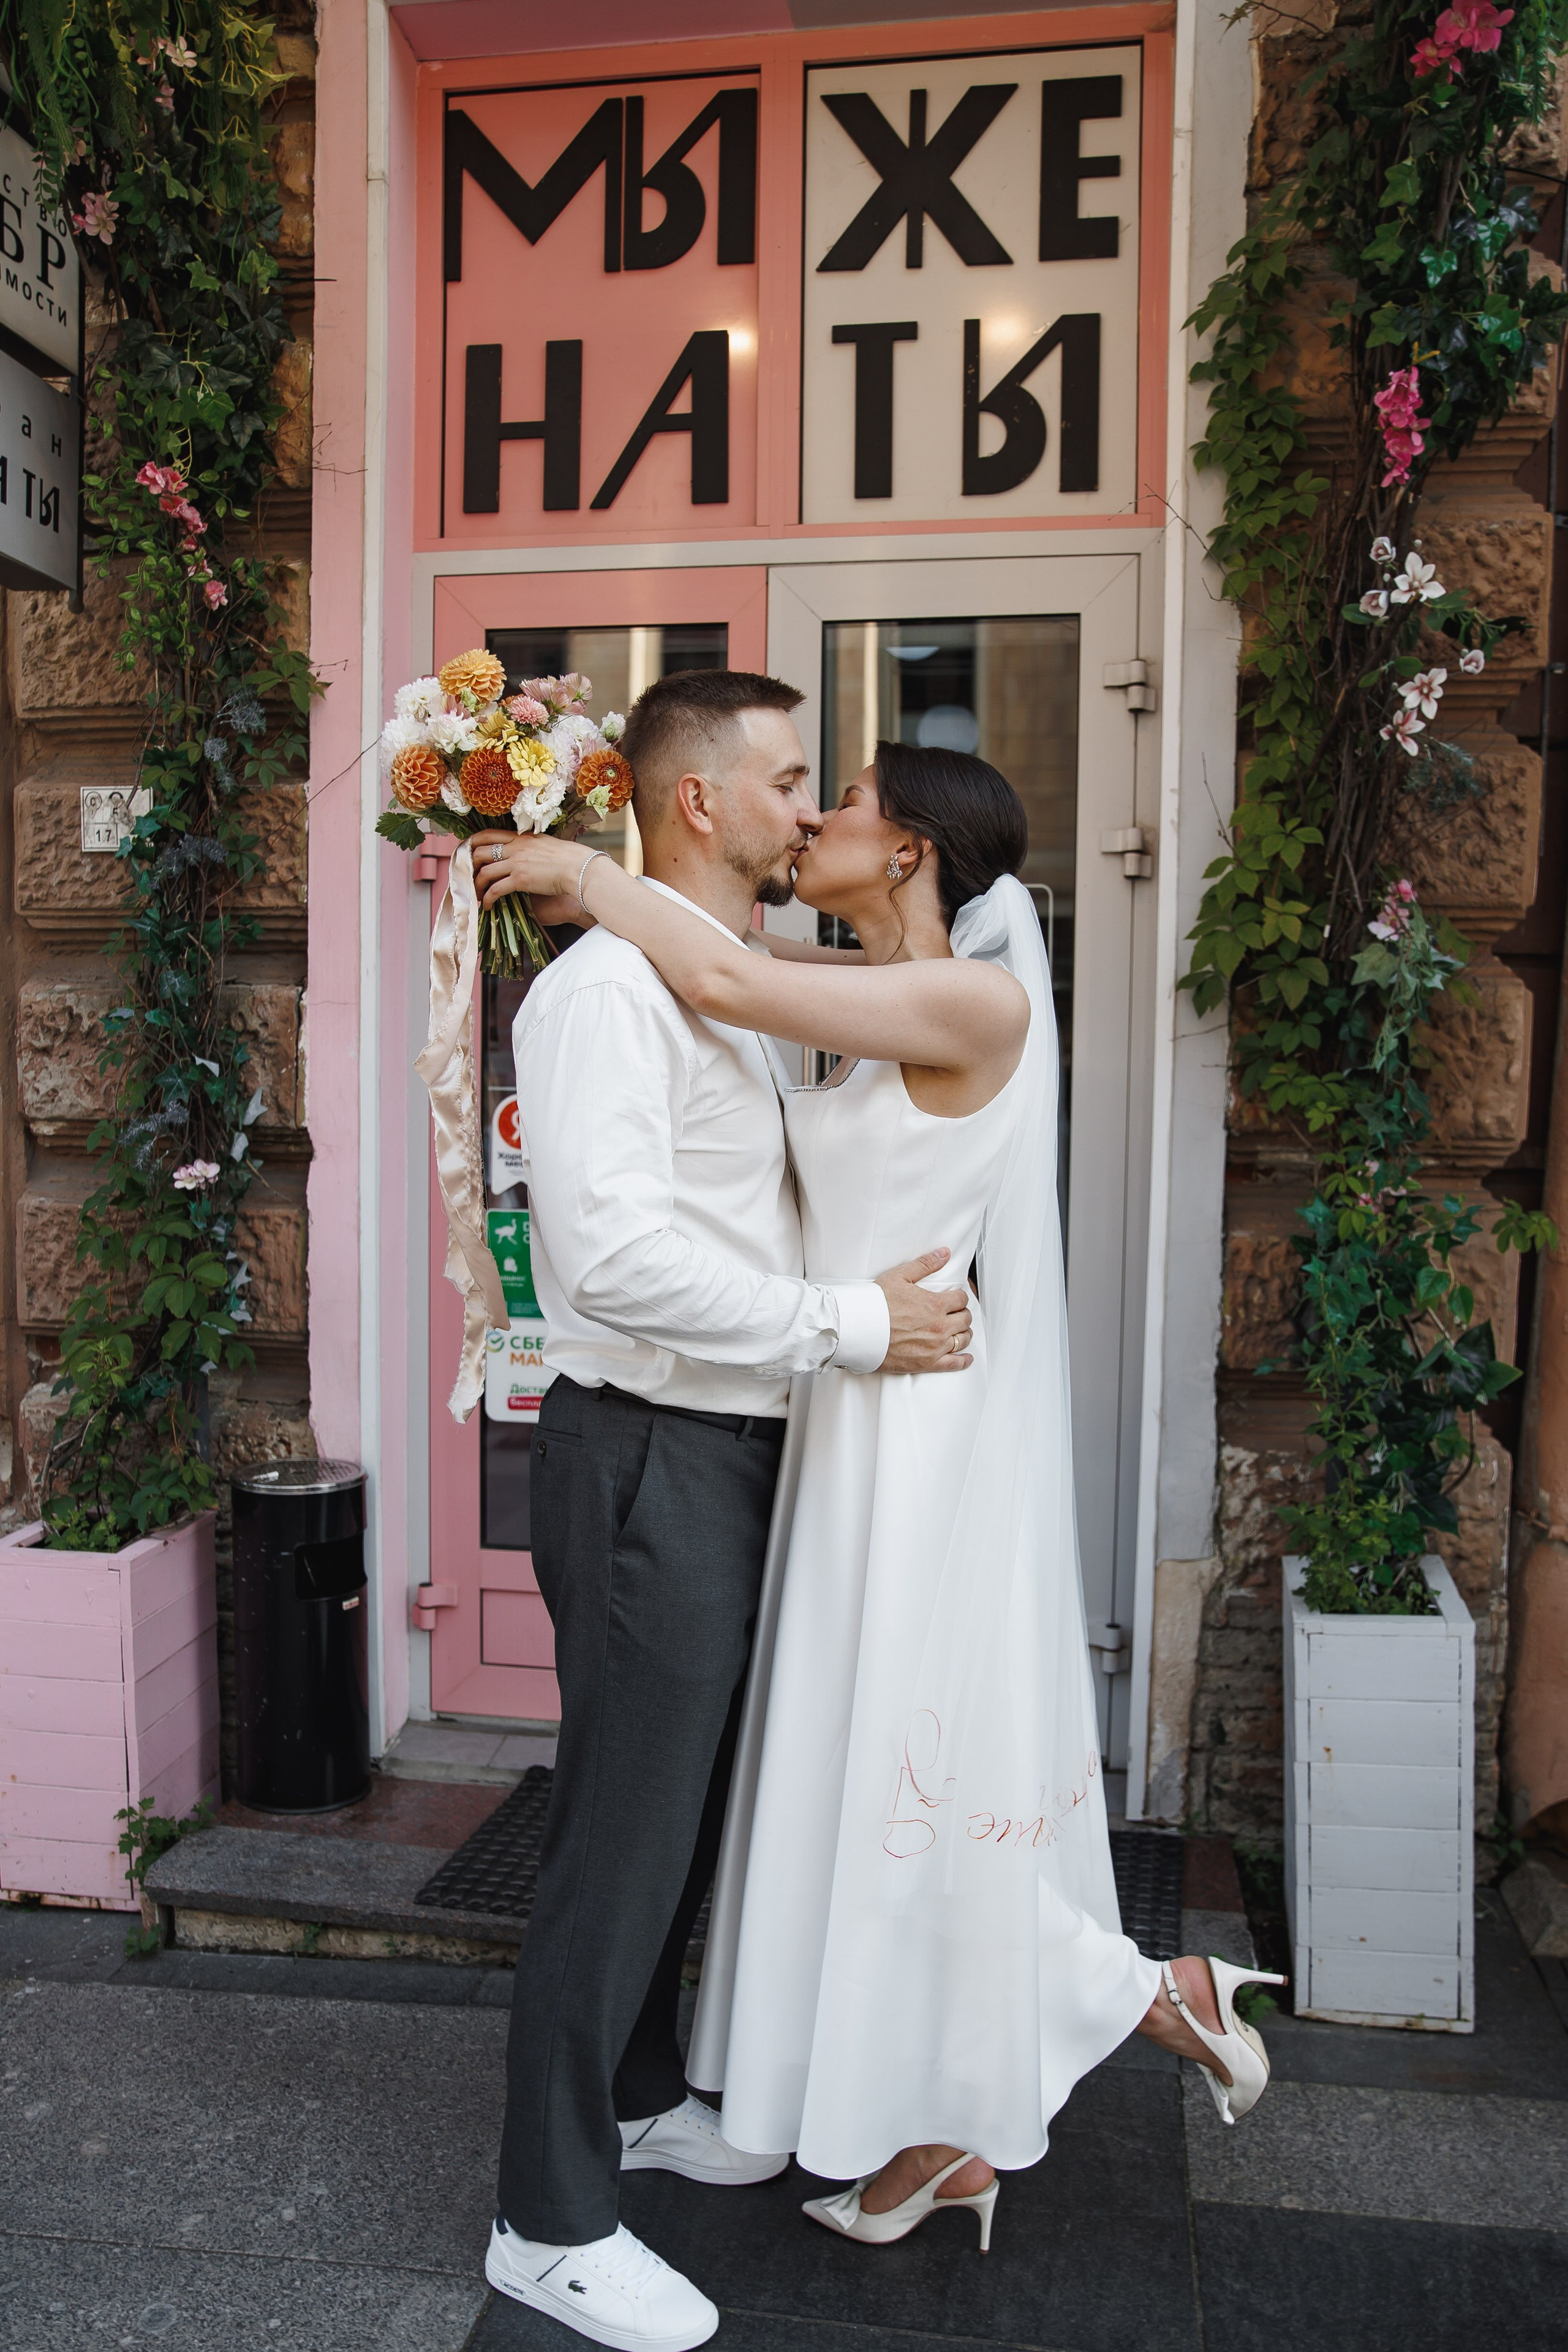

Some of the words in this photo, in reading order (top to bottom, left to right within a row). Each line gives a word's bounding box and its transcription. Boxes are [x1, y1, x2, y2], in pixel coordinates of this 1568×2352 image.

[444, 86, 759, 282] МЫ
[816, 74, 1123, 273] ЖЕ
[0, 263, 67, 327] МОСТИ
[462, 329, 729, 514] НА
[831, 312, 1101, 499] ТЫ
[96, 829, 111, 842] 17
